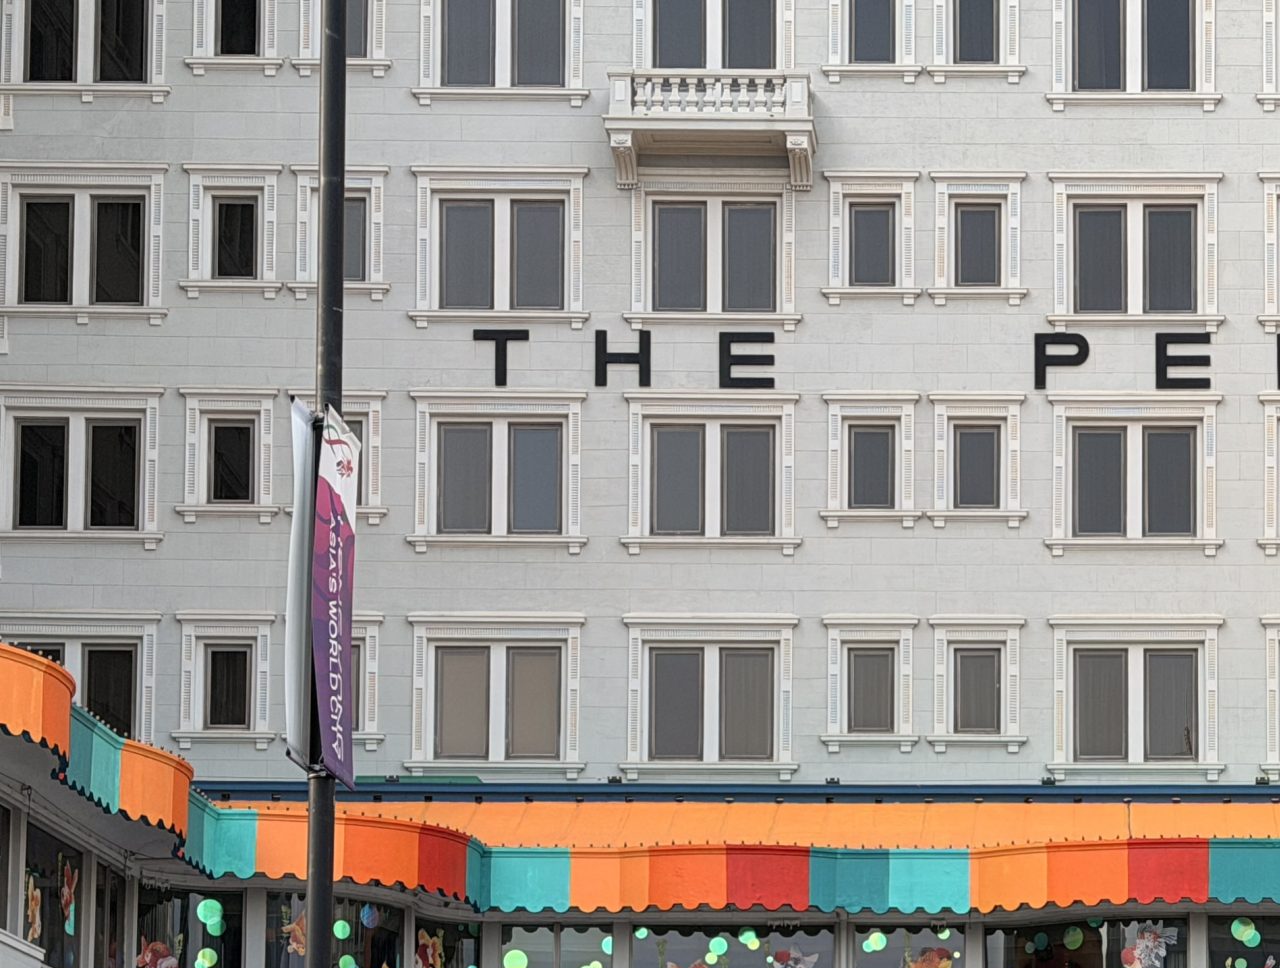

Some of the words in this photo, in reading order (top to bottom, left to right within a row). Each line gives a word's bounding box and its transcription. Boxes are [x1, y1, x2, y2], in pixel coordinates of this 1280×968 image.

[473, 329, 775, 388] THE
[328, 511, 338, 593] ASIA'S
[328, 600, 339, 690] WORLD
